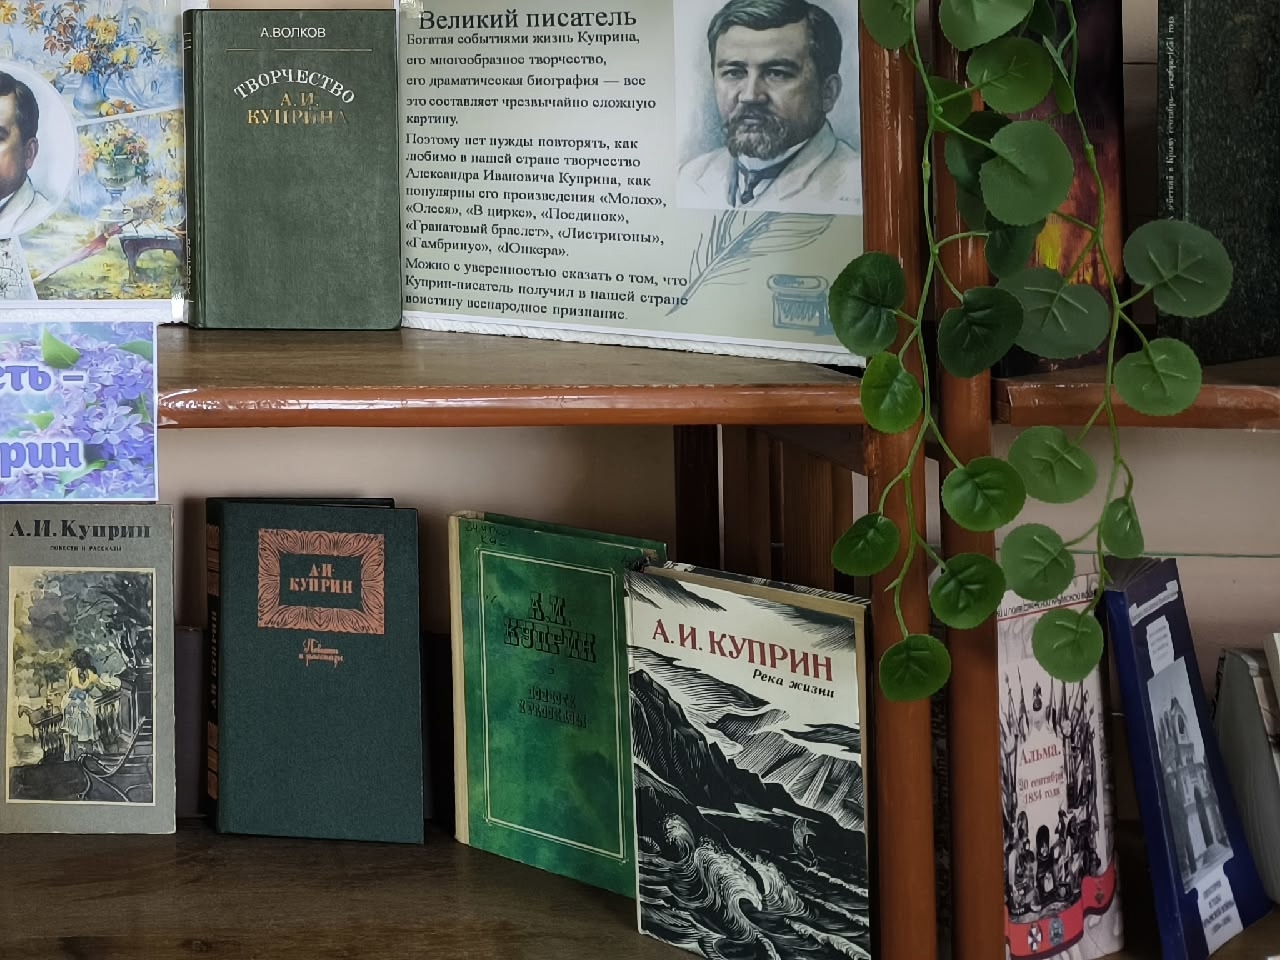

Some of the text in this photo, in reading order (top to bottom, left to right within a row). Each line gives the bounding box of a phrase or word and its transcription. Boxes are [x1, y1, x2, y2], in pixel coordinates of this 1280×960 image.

[419, 9, 637, 29] Великий писатель
[261, 27, 326, 38] А.ВОЛКОВ
[407, 32, 640, 45] Богатая событиями жизнь Куприна,
[407, 54, 607, 67] его многообразное творчество,
[233, 69, 355, 103] ТВОРЧЕСТВО
[407, 77, 425, 85] его
[429, 76, 523, 88] драматическая
[528, 75, 598, 88] биография
[407, 96, 656, 111] это составляет чрезвычайно сложную
[407, 115, 459, 126] картину.
[406, 133, 638, 150] Поэтому нет нужды повторять, как
[406, 152, 456, 162] любимо
[472, 153, 512, 163] нашей
[516, 157, 559, 167] стране
[564, 157, 640, 169] творчество
[406, 168, 651, 187] Александра Ивановича Куприна, как
[406, 188, 666, 207] популярны его произведения «Молох»,
[406, 203, 629, 224] «Олеся», «В цирке», «Поединок»,
[406, 221, 664, 245] «Гранатовый браслет», «Листригоны»,
[406, 239, 569, 257] «Гамбринус», «Юнкера».
[405, 258, 687, 286] Можно с уверенностью сказать о том, что
[405, 275, 688, 306] Куприн-писатель получил в нашей стране
[405, 296, 628, 320] воистину всенародное признание.
[290, 577, 353, 593] КУПРИН
[504, 616, 596, 663] КУПРИН
[709, 631, 832, 681] КУПРИН
[753, 669, 834, 698] Река жизни
